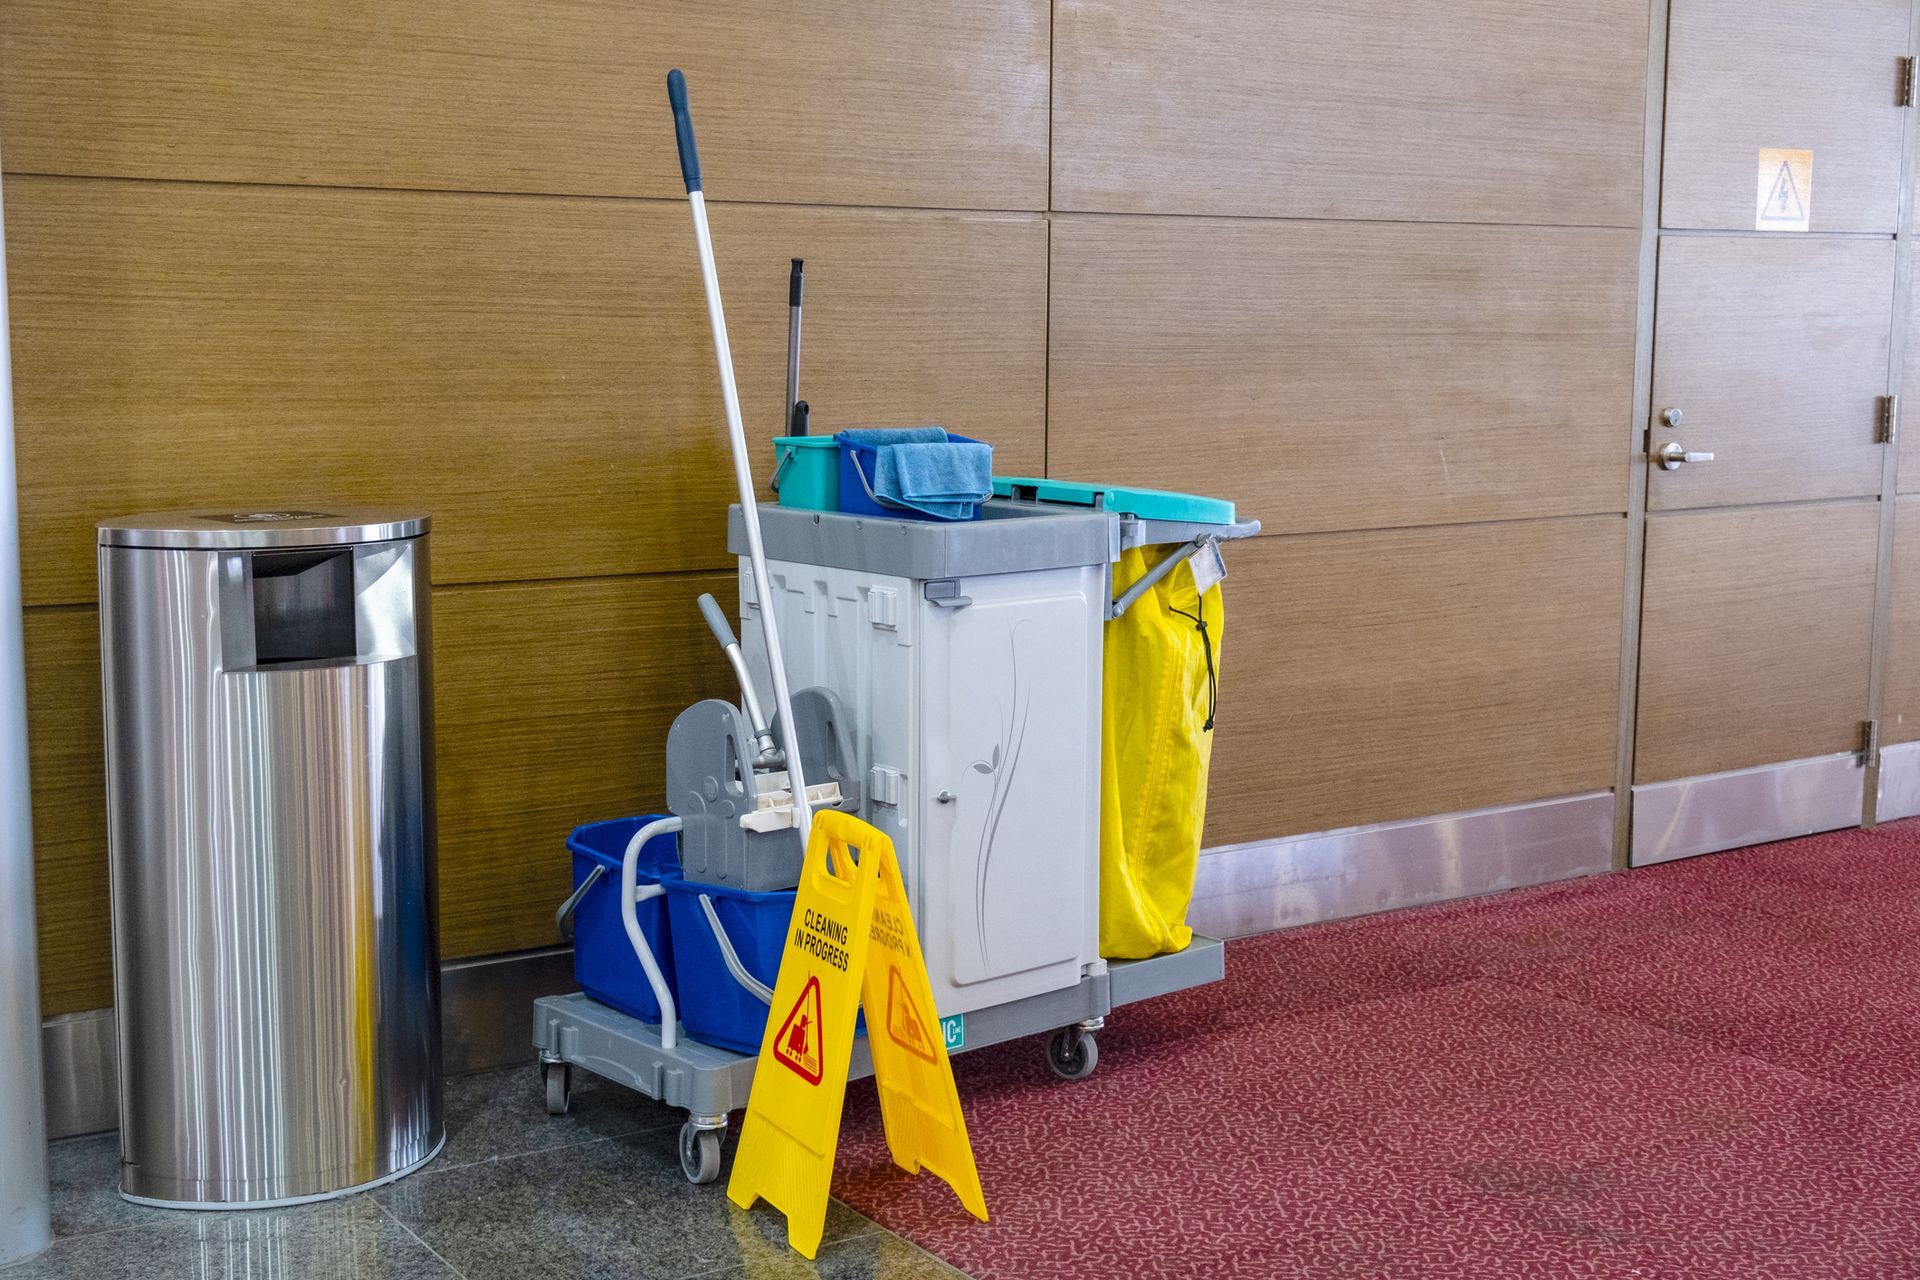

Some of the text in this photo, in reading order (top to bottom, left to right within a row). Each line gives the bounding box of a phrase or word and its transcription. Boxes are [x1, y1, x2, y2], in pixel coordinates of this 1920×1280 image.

[804, 908, 848, 946] CLEANING
[794, 928, 849, 972] IN PROGRESS
